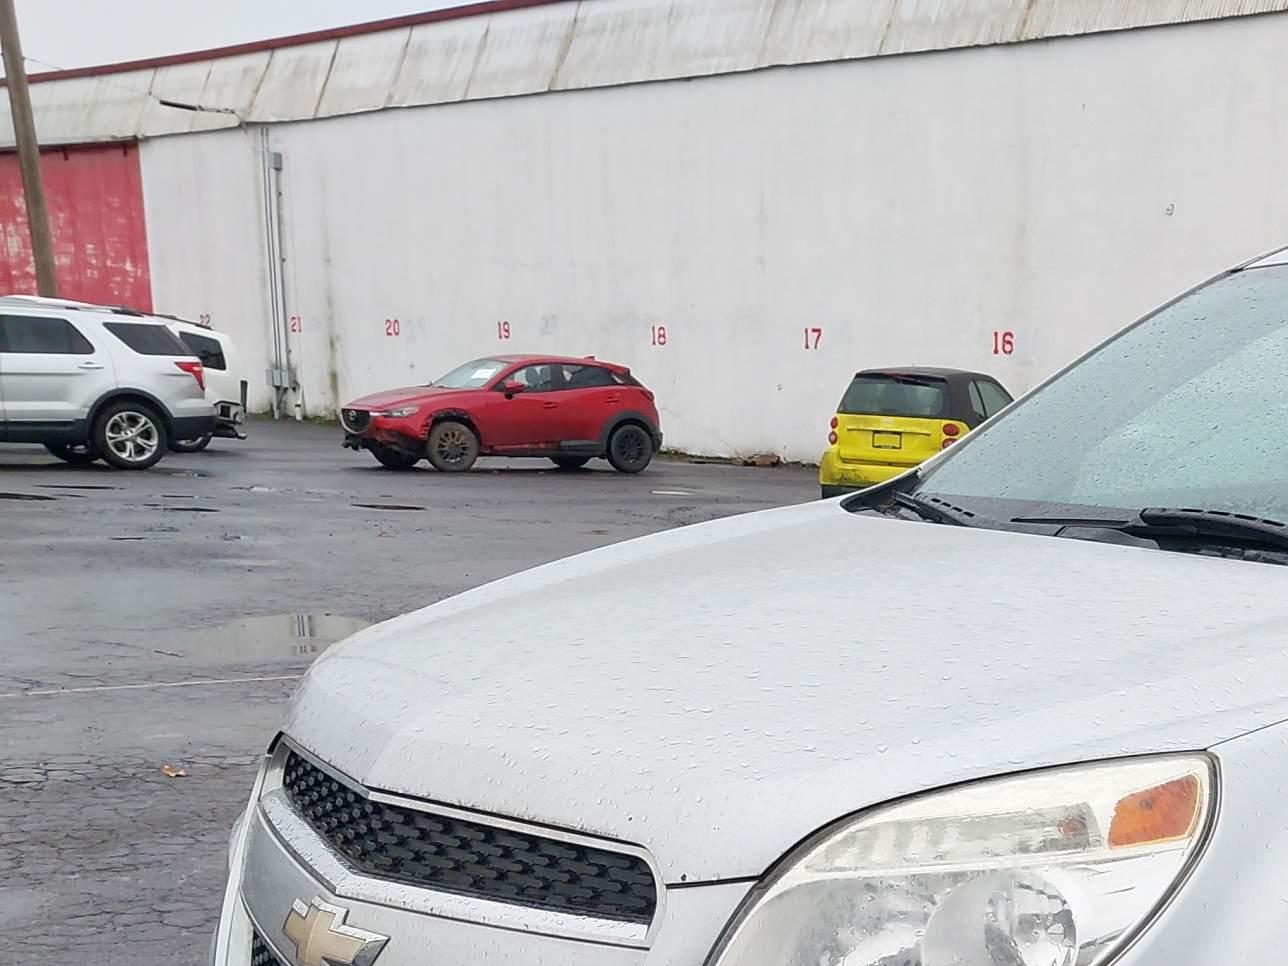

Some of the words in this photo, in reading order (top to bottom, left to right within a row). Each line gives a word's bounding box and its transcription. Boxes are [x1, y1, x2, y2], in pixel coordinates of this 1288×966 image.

[290, 315, 303, 333] 21
[384, 319, 400, 337] 20
[497, 321, 511, 340] 19
[650, 325, 667, 346] 18
[804, 327, 822, 350] 17
[993, 330, 1014, 355] 16
